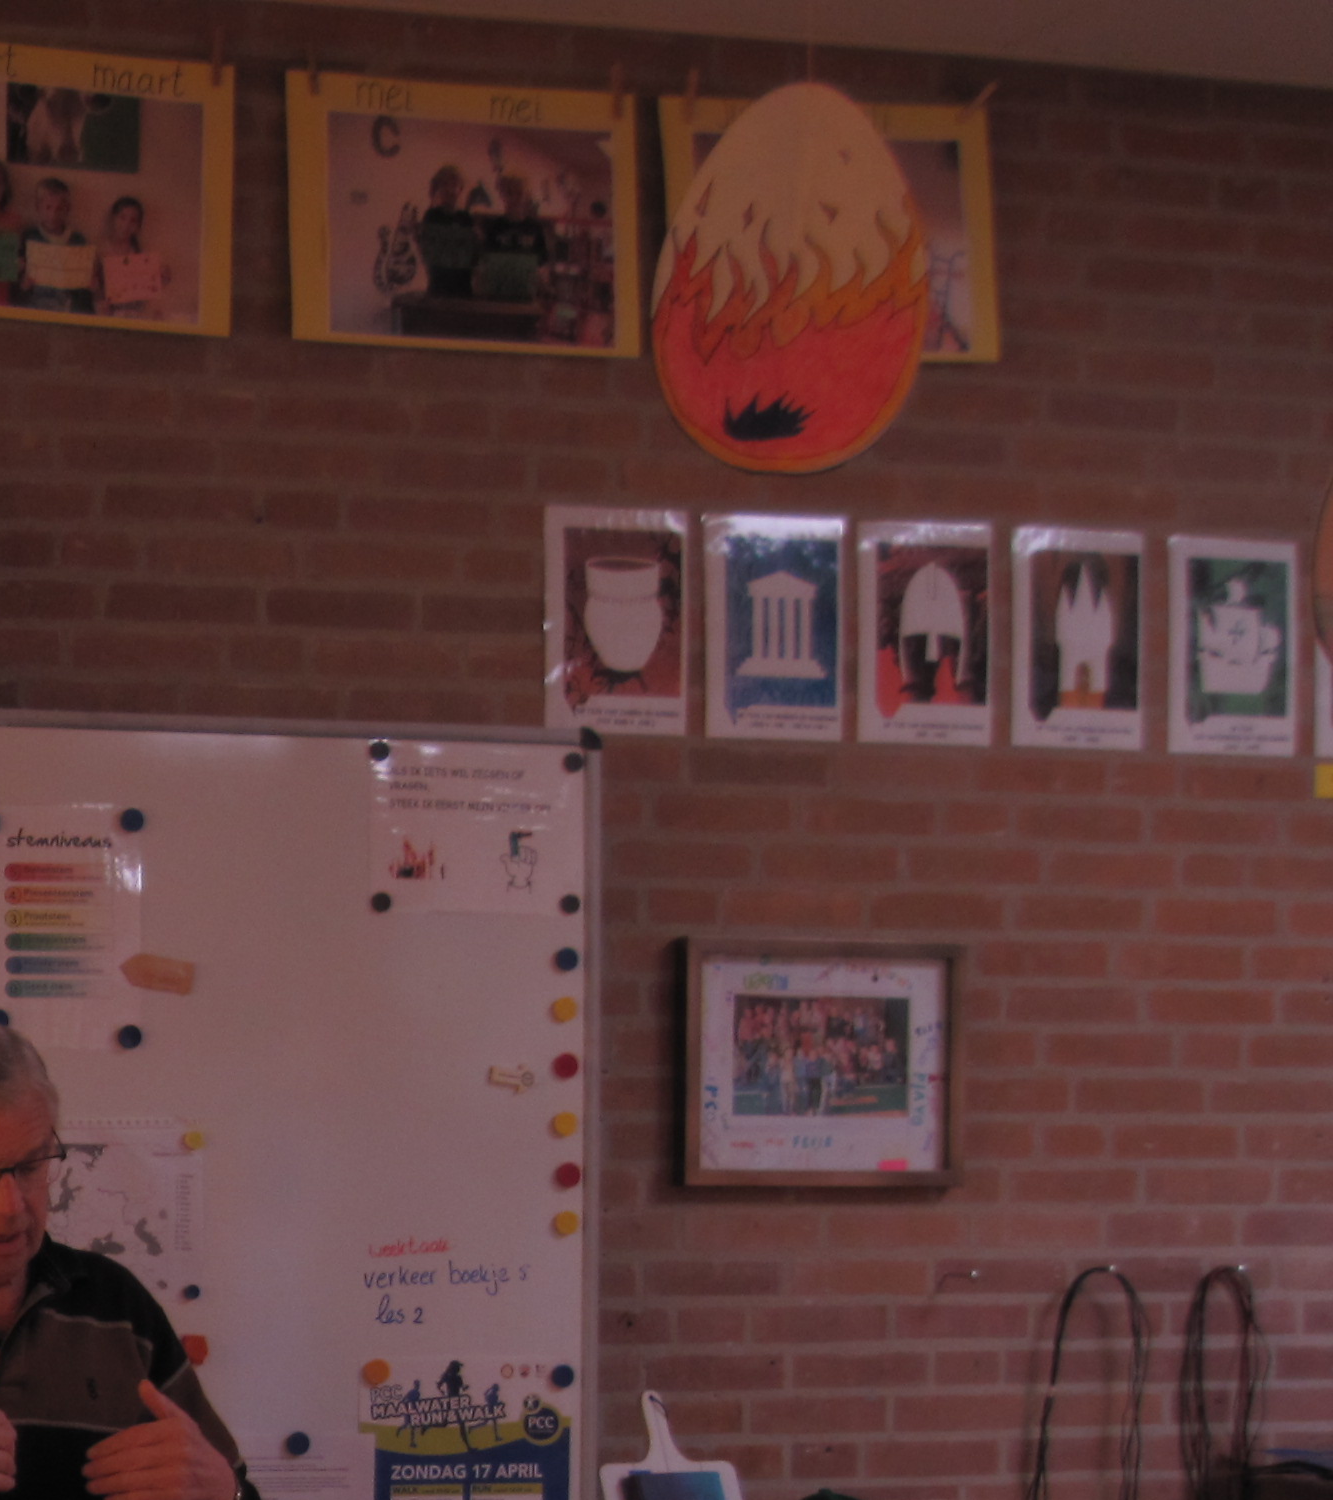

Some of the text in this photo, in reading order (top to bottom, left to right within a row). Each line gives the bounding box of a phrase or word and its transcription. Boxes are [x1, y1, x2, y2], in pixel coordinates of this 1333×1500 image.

[92, 60, 185, 98] maart
[355, 80, 542, 123] mei mei
[6, 828, 112, 848] stemniveaus
[363, 1265, 437, 1290] verkeer
[412, 1306, 424, 1325] 2
[371, 1394, 473, 1421] MAALWATER
[410, 1411, 446, 1428] RUN
[459, 1401, 508, 1423] WALK
[526, 1415, 555, 1429] PCC
[390, 1462, 544, 1481] ZONDAG 17 APRIL
